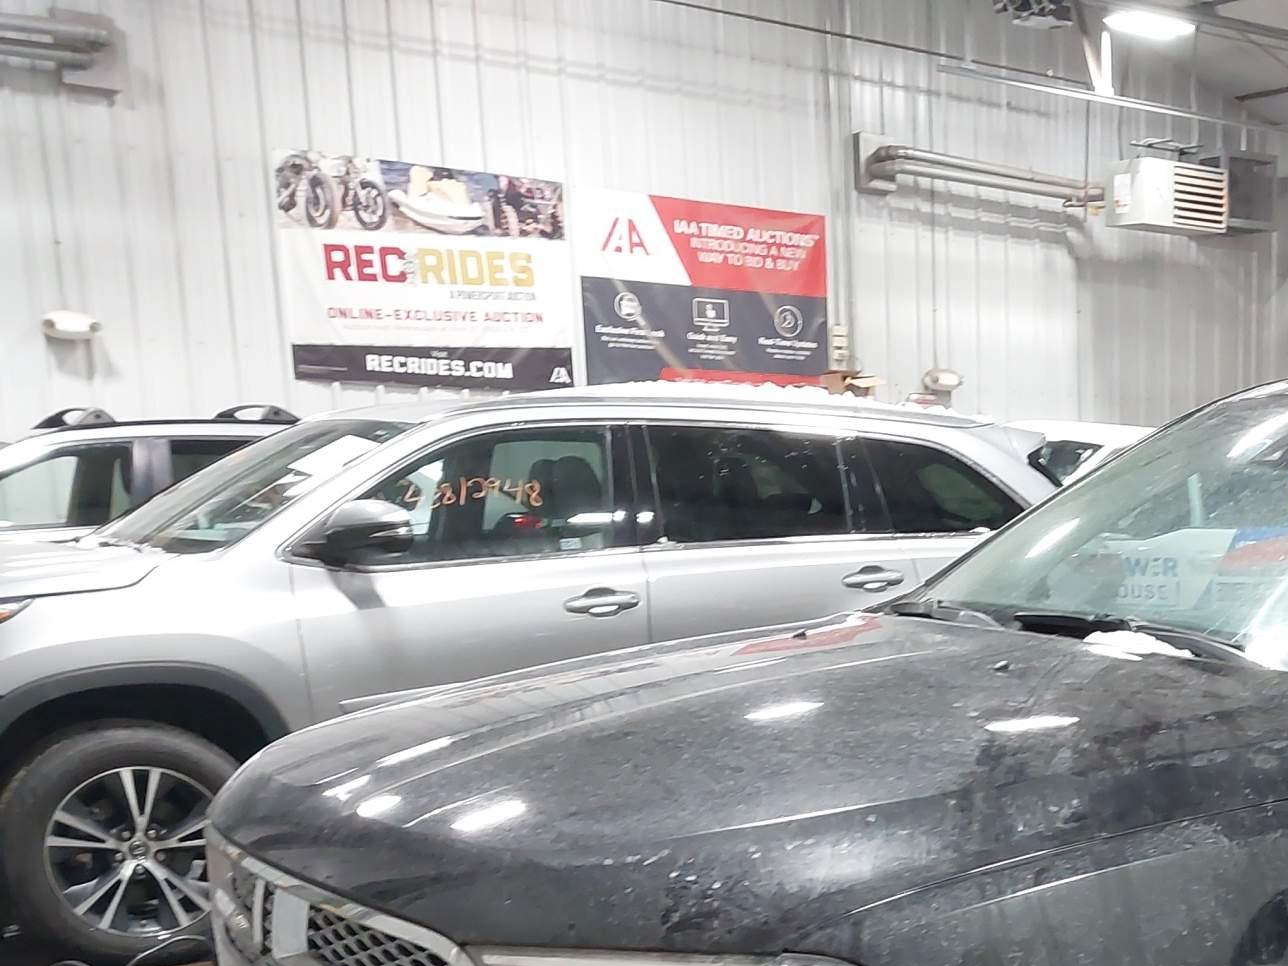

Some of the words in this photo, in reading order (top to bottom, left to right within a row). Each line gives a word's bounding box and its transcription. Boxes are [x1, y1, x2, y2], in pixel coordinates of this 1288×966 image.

[698, 221, 744, 239] TIMED
[322, 243, 407, 283] REC
[416, 247, 534, 287] RIDES
[327, 307, 478, 323] ONLINE-EXCLUSIVE
[484, 311, 543, 323] AUCTION
[365, 353, 514, 379] RECRIDES.COM
